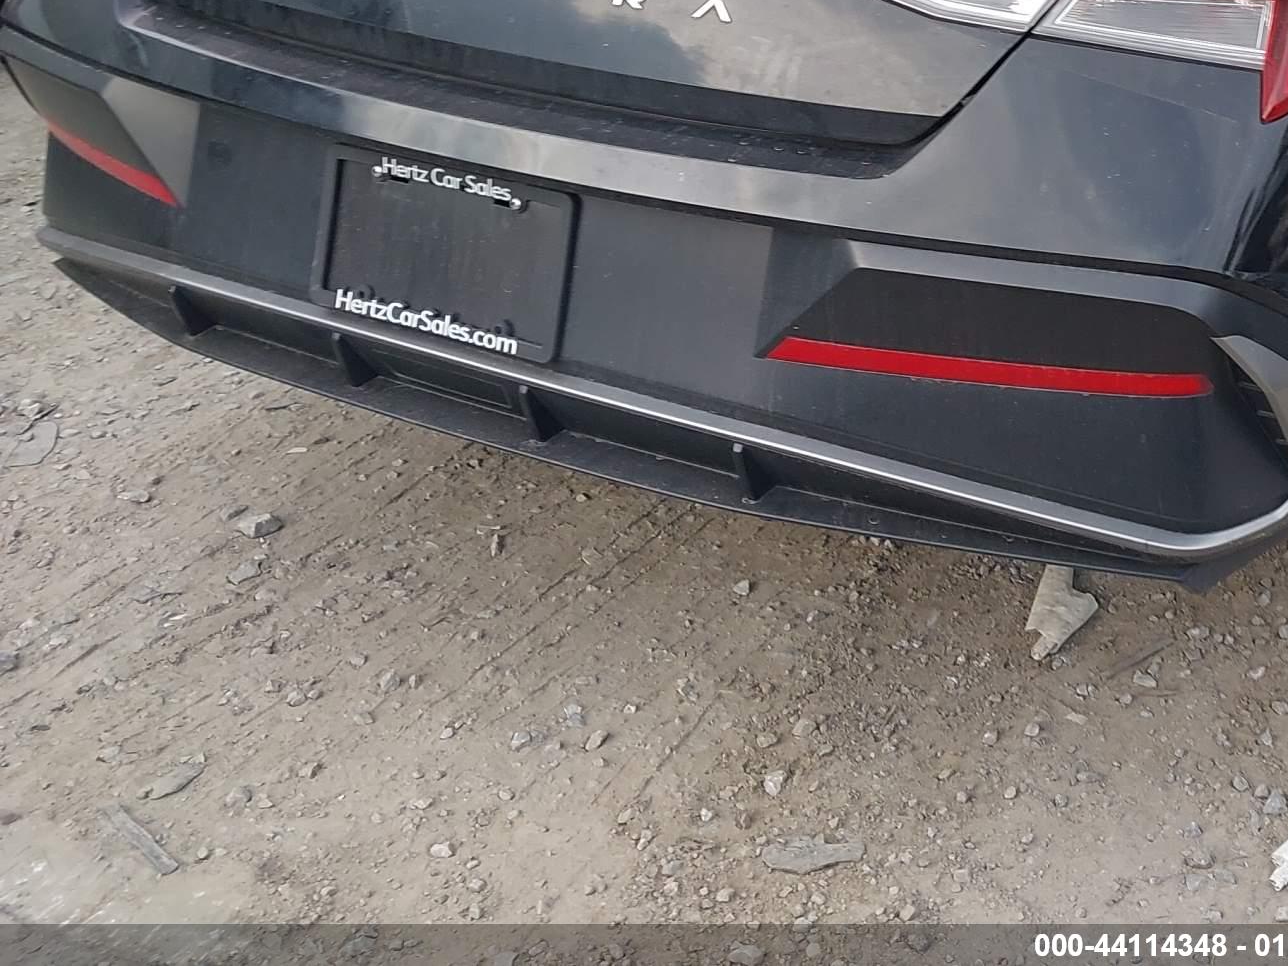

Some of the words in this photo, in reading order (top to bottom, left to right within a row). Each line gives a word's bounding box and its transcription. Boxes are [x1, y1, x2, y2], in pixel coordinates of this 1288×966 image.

[381, 156, 429, 183] Hertz
[430, 167, 463, 190] Car
[464, 175, 512, 201] Sales
[334, 289, 518, 355] HertzCarSales.com
